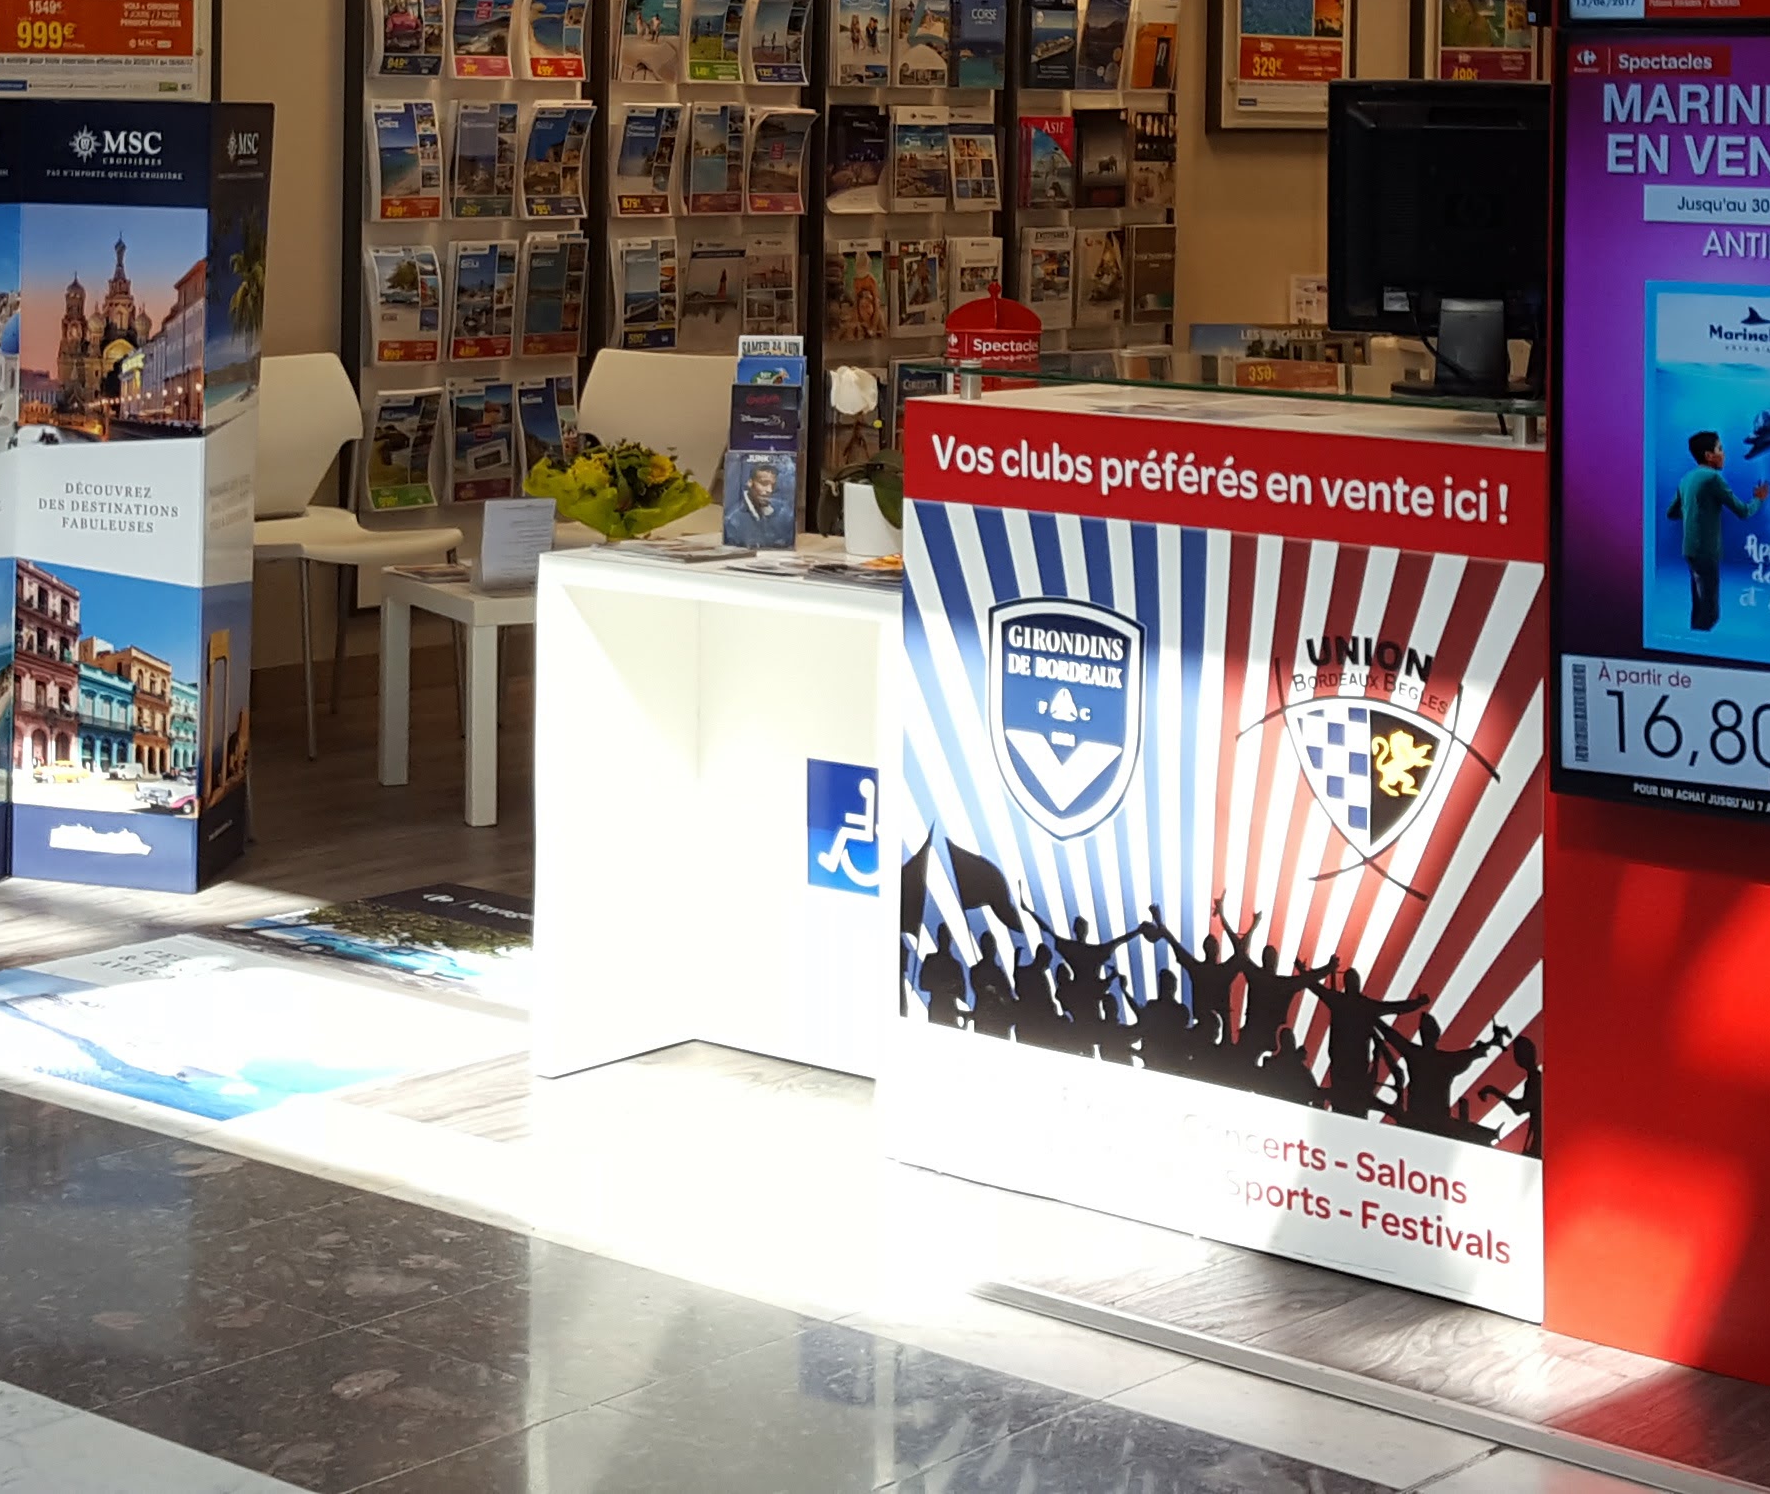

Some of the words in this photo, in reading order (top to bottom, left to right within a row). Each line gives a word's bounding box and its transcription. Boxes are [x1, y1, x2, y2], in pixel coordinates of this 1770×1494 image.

[17, 20, 77, 49] 999€
[1618, 53, 1713, 71] Spectacles
[1042, 120, 1065, 134] ASIE
[102, 130, 163, 155] MSC
[237, 131, 260, 155] MSC
[1607, 133, 1669, 175] EN
[1677, 195, 1747, 215] Jusqu'au
[1752, 198, 1770, 214] 30
[972, 338, 1040, 355] Spectacles
[65, 480, 152, 499] DÉCOUVREZ
[932, 433, 995, 476] Vos
[1001, 439, 1093, 485] clubs
[1100, 450, 1258, 501] préférés
[1266, 471, 1313, 505] en
[1321, 475, 1434, 519] vente
[1442, 476, 1488, 523] ici
[1496, 483, 1510, 525] !
[38, 497, 65, 511] DES
[71, 499, 179, 519] DESTINATIONS
[61, 516, 154, 534] FABULEUSES
[1007, 624, 1124, 662] GIRONDINS
[1007, 653, 1031, 676] DE
[1034, 656, 1123, 690] BORDEAUX
[1306, 635, 1434, 683] UNION
[1598, 661, 1612, 682] À
[1616, 667, 1662, 687] partir
[1668, 670, 1692, 688] de
[1292, 670, 1380, 693] BORDEAUX
[1382, 670, 1449, 716] BEGLES
[1633, 782, 1659, 796] POUR
[1660, 786, 1675, 798] UN
[1676, 788, 1706, 805] ACHAT
[1708, 793, 1755, 812] JUSQU'AU
[1757, 799, 1764, 813] 7
[1184, 1112, 1327, 1171] Cncerts
[1333, 1158, 1349, 1169] -
[1356, 1151, 1468, 1205] Salons
[1227, 1168, 1330, 1221] Sports
[1338, 1207, 1353, 1219] -
[1361, 1199, 1511, 1265] Festivals
